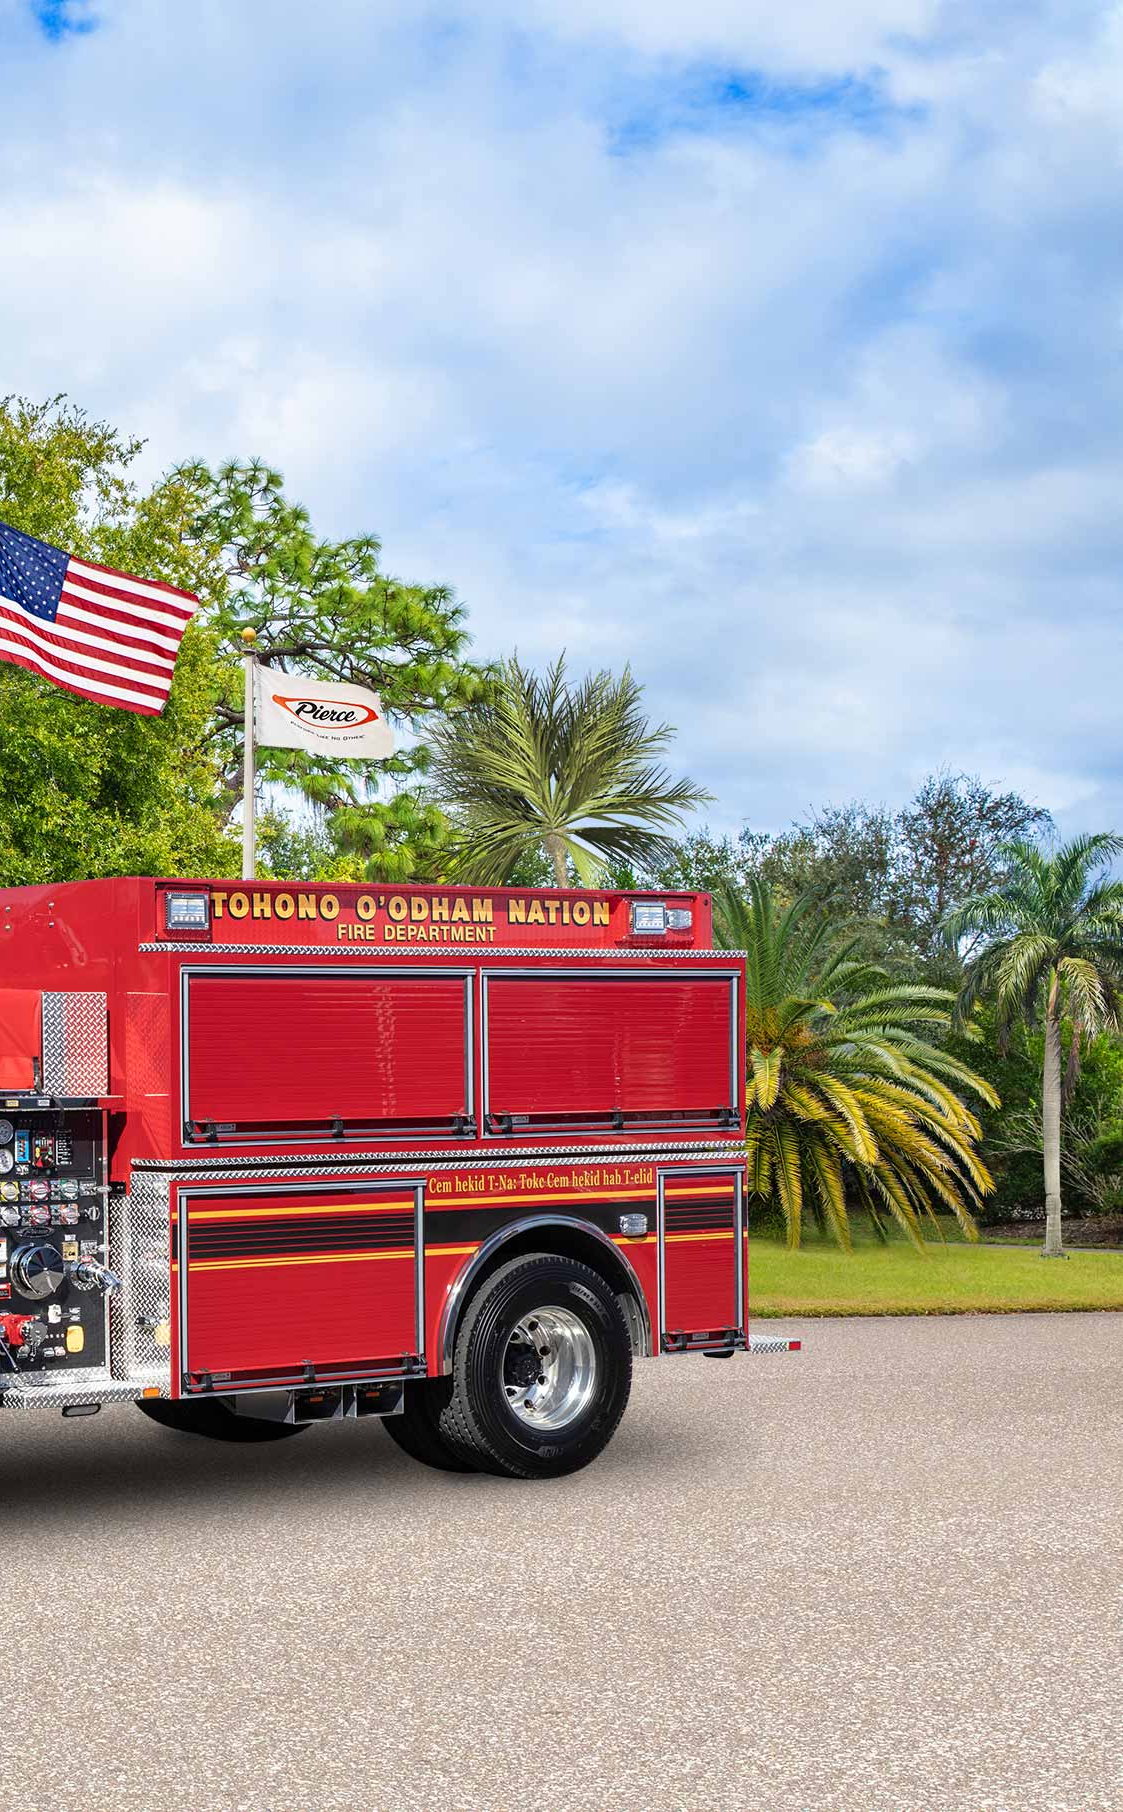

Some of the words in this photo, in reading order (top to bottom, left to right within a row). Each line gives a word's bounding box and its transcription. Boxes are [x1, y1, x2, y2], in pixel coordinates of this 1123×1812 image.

[295, 702, 357, 722] Pierce
[211, 892, 340, 920] TOHONO
[356, 895, 493, 923] O'ODHAM
[508, 899, 610, 926] NATION
[337, 924, 375, 941] FIRE
[384, 924, 497, 942] DEPARTMENT
[429, 1177, 452, 1194] Cem
[455, 1174, 485, 1192] hekid
[547, 1172, 569, 1188] Cem
[572, 1169, 600, 1187] hekid
[603, 1168, 621, 1185] hab
[624, 1167, 653, 1184] T-elid
